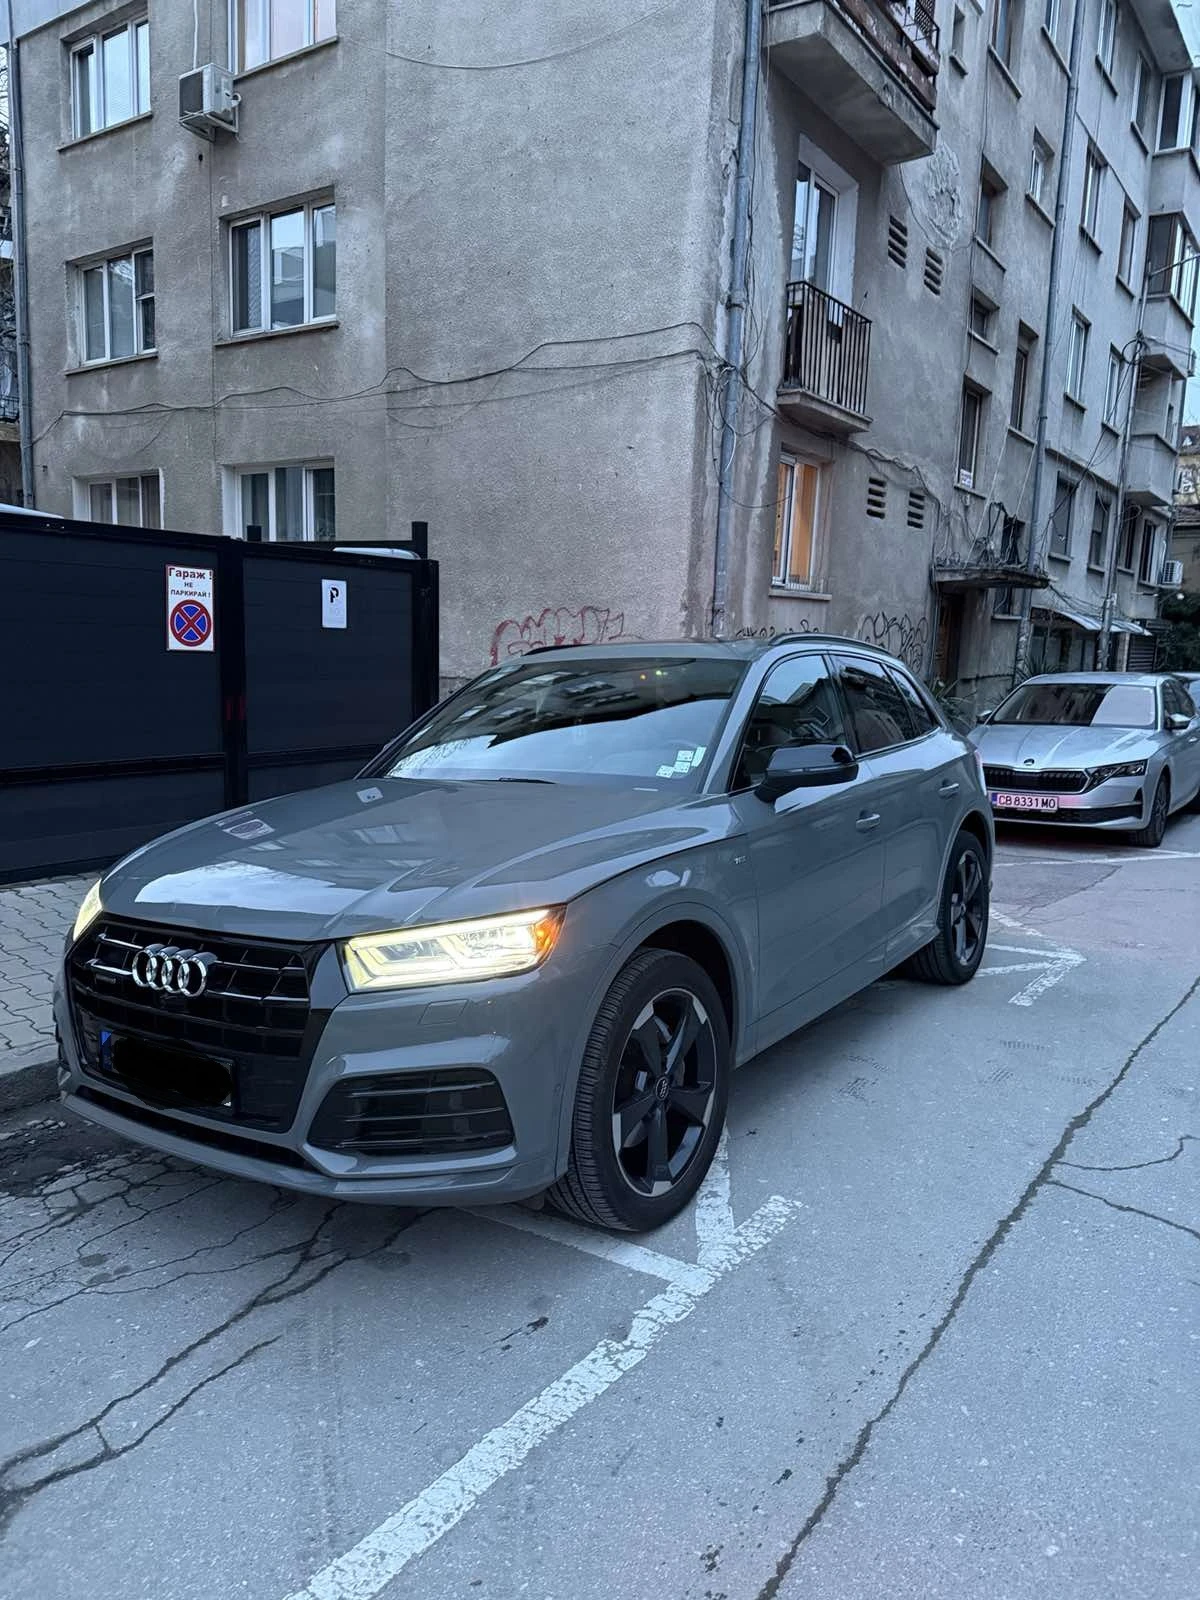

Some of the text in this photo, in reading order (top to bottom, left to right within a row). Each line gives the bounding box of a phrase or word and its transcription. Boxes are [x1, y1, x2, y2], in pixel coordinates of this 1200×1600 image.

[169, 567, 206, 580] Гараж
[170, 590, 206, 598] ПАРКИРАЙ
[999, 795, 1056, 809] CB 8331 MO
